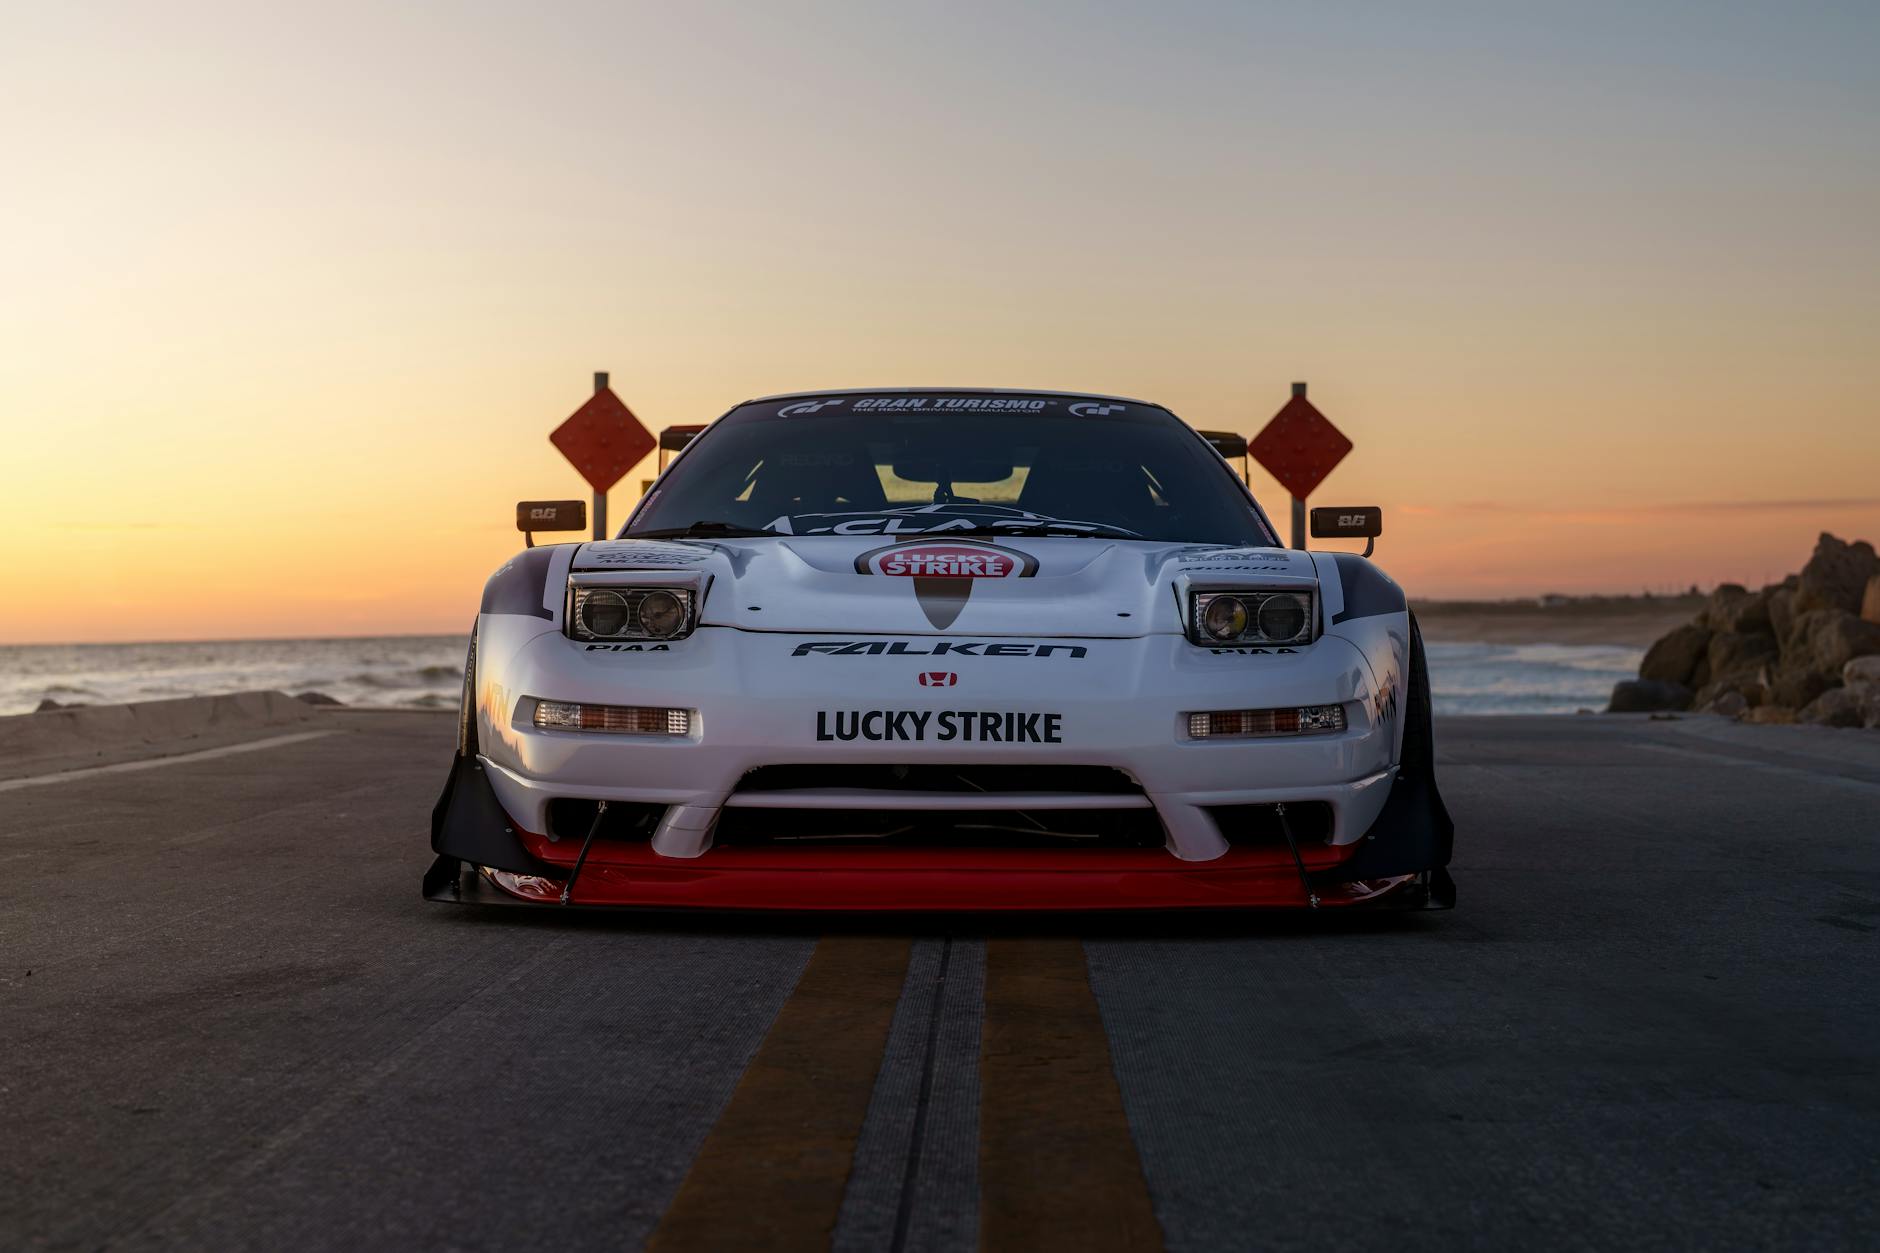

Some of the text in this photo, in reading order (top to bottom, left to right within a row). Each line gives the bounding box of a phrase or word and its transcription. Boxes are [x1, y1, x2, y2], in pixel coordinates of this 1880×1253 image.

[853, 398, 1046, 409] GRAN TURISMO
[894, 553, 1001, 563] LUCKY
[886, 562, 1004, 577] STRIKE
[791, 641, 1088, 659] FALKEN
[816, 711, 1063, 743] LUCKY STRIKE
